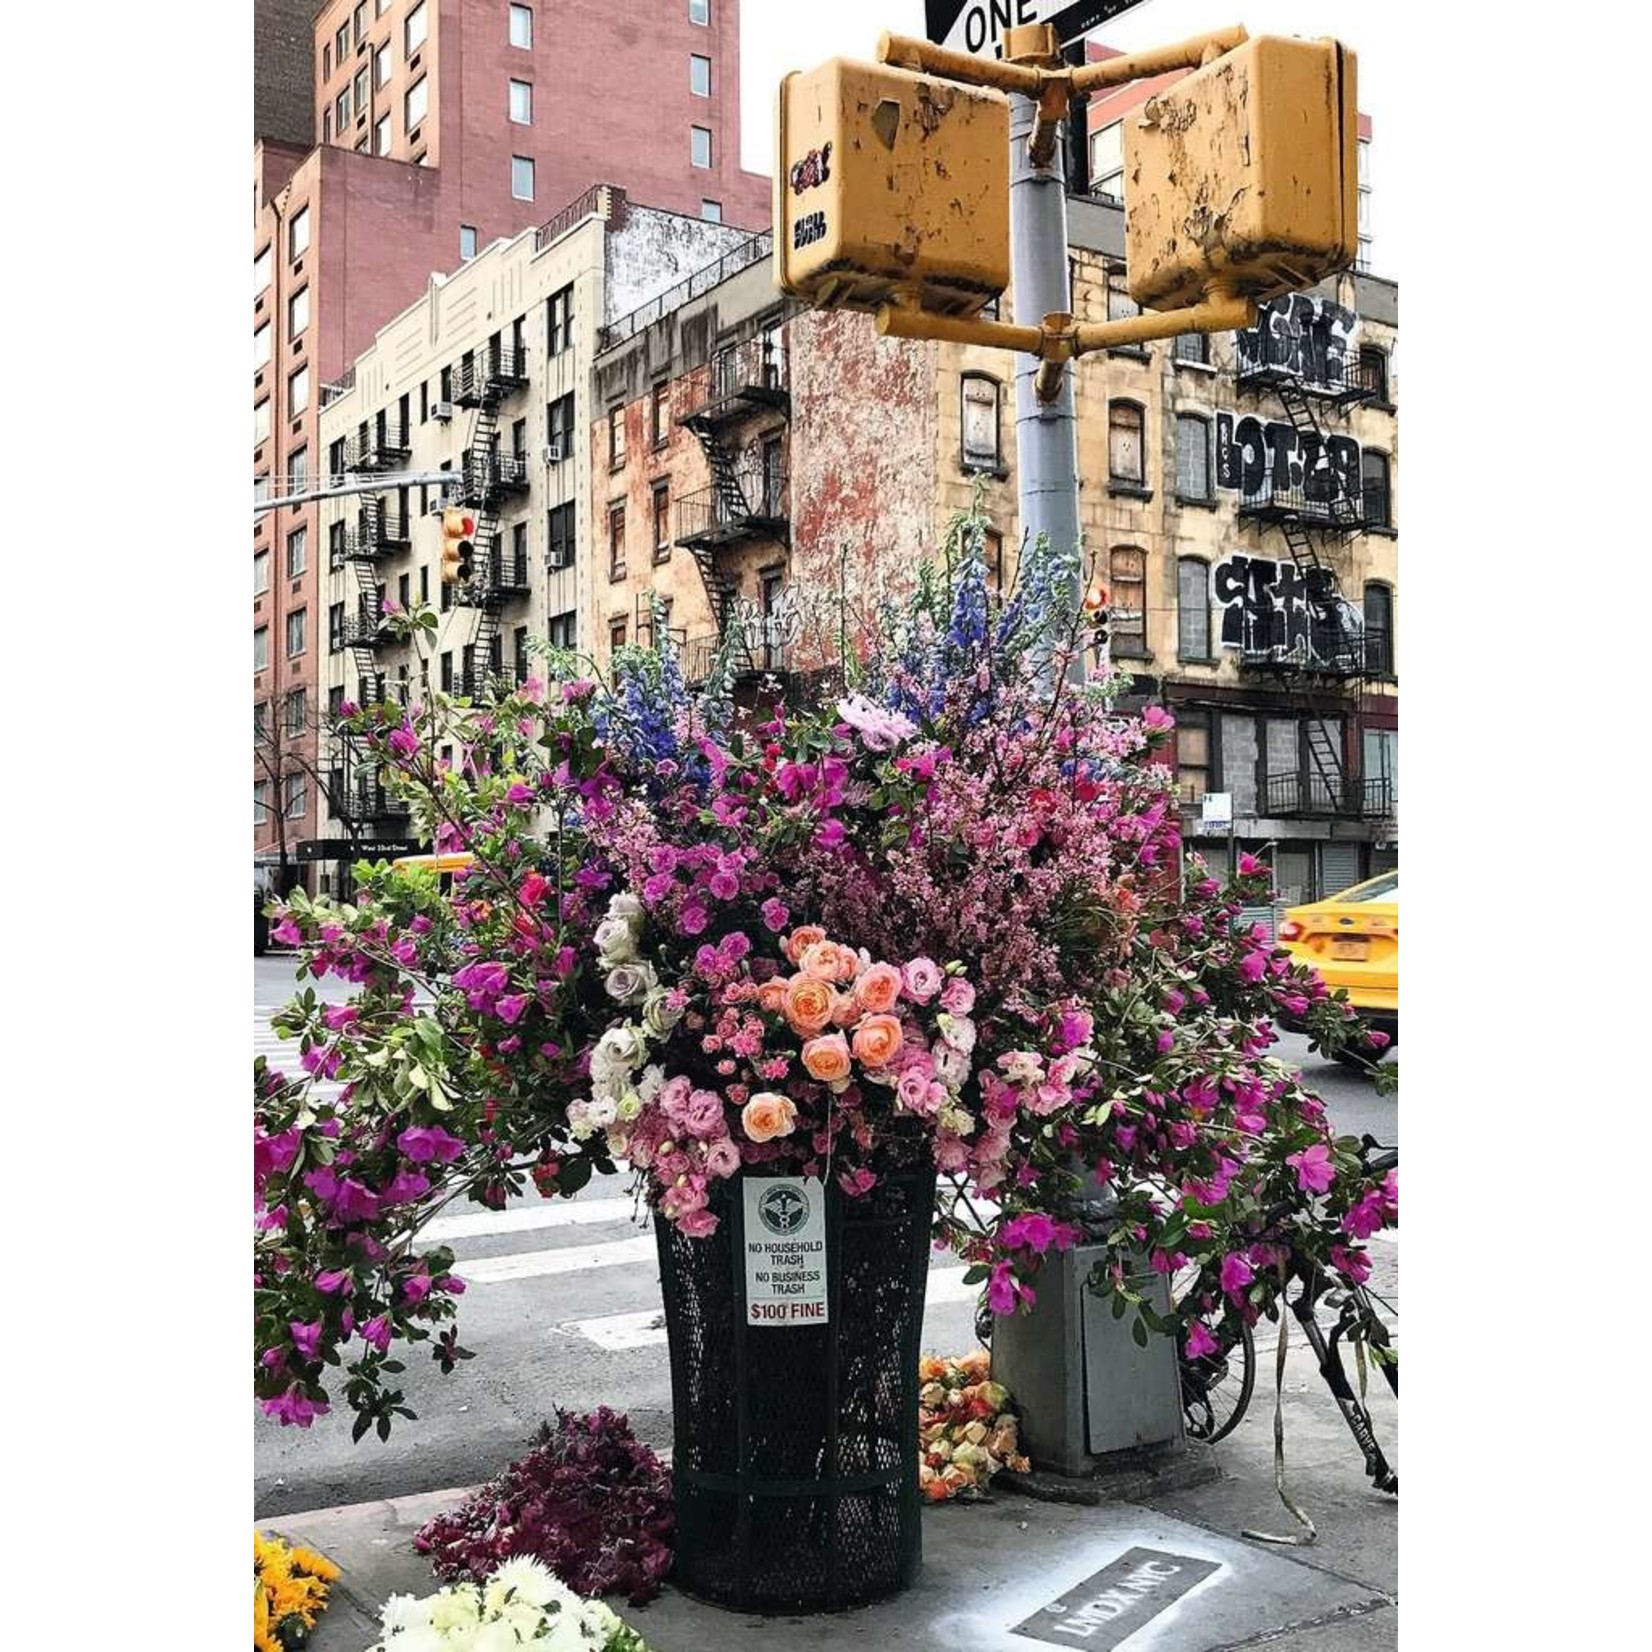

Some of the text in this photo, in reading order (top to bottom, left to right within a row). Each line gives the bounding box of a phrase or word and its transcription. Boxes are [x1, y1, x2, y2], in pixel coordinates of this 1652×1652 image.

[965, 0, 1037, 53] ONE
[748, 1241, 823, 1253] NO HOUSEHOLD
[770, 1254, 804, 1266] TRASH
[755, 1271, 821, 1282] NO BUSINESS
[771, 1283, 805, 1295] TRASH
[750, 1302, 825, 1319] $100 FINE
